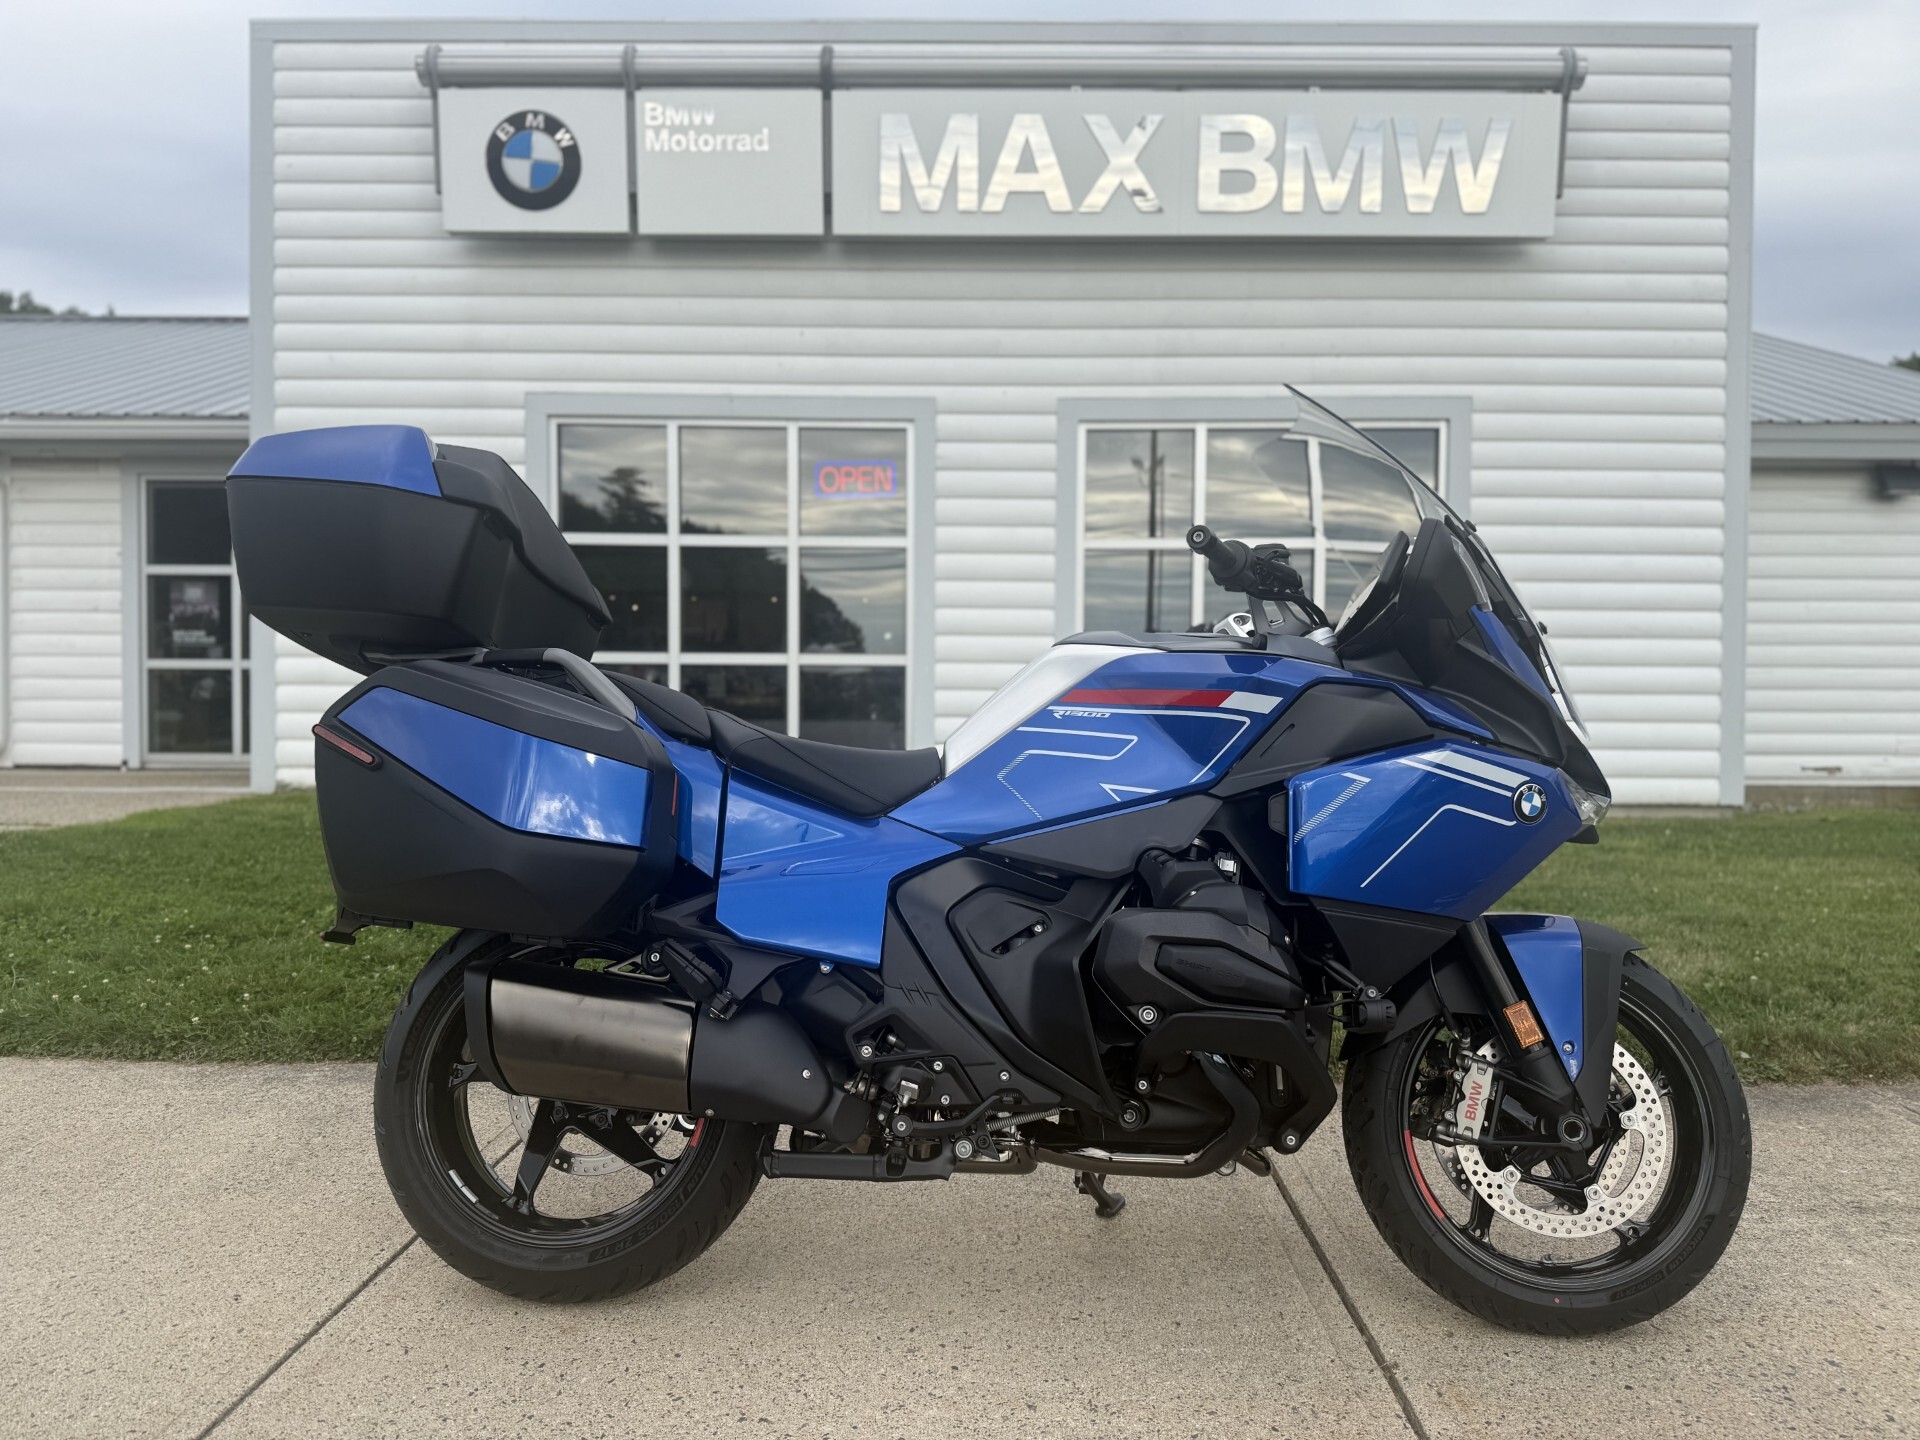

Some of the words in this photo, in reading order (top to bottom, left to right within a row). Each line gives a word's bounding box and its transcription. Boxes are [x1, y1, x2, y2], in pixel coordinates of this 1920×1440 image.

[496, 112, 574, 148] BMW
[644, 102, 715, 126] BMW
[644, 128, 770, 152] Motorrad
[879, 113, 1164, 213] MAX
[1197, 114, 1512, 214] BMW
[818, 465, 893, 494] OPEN
[1464, 1080, 1483, 1121] BMW
